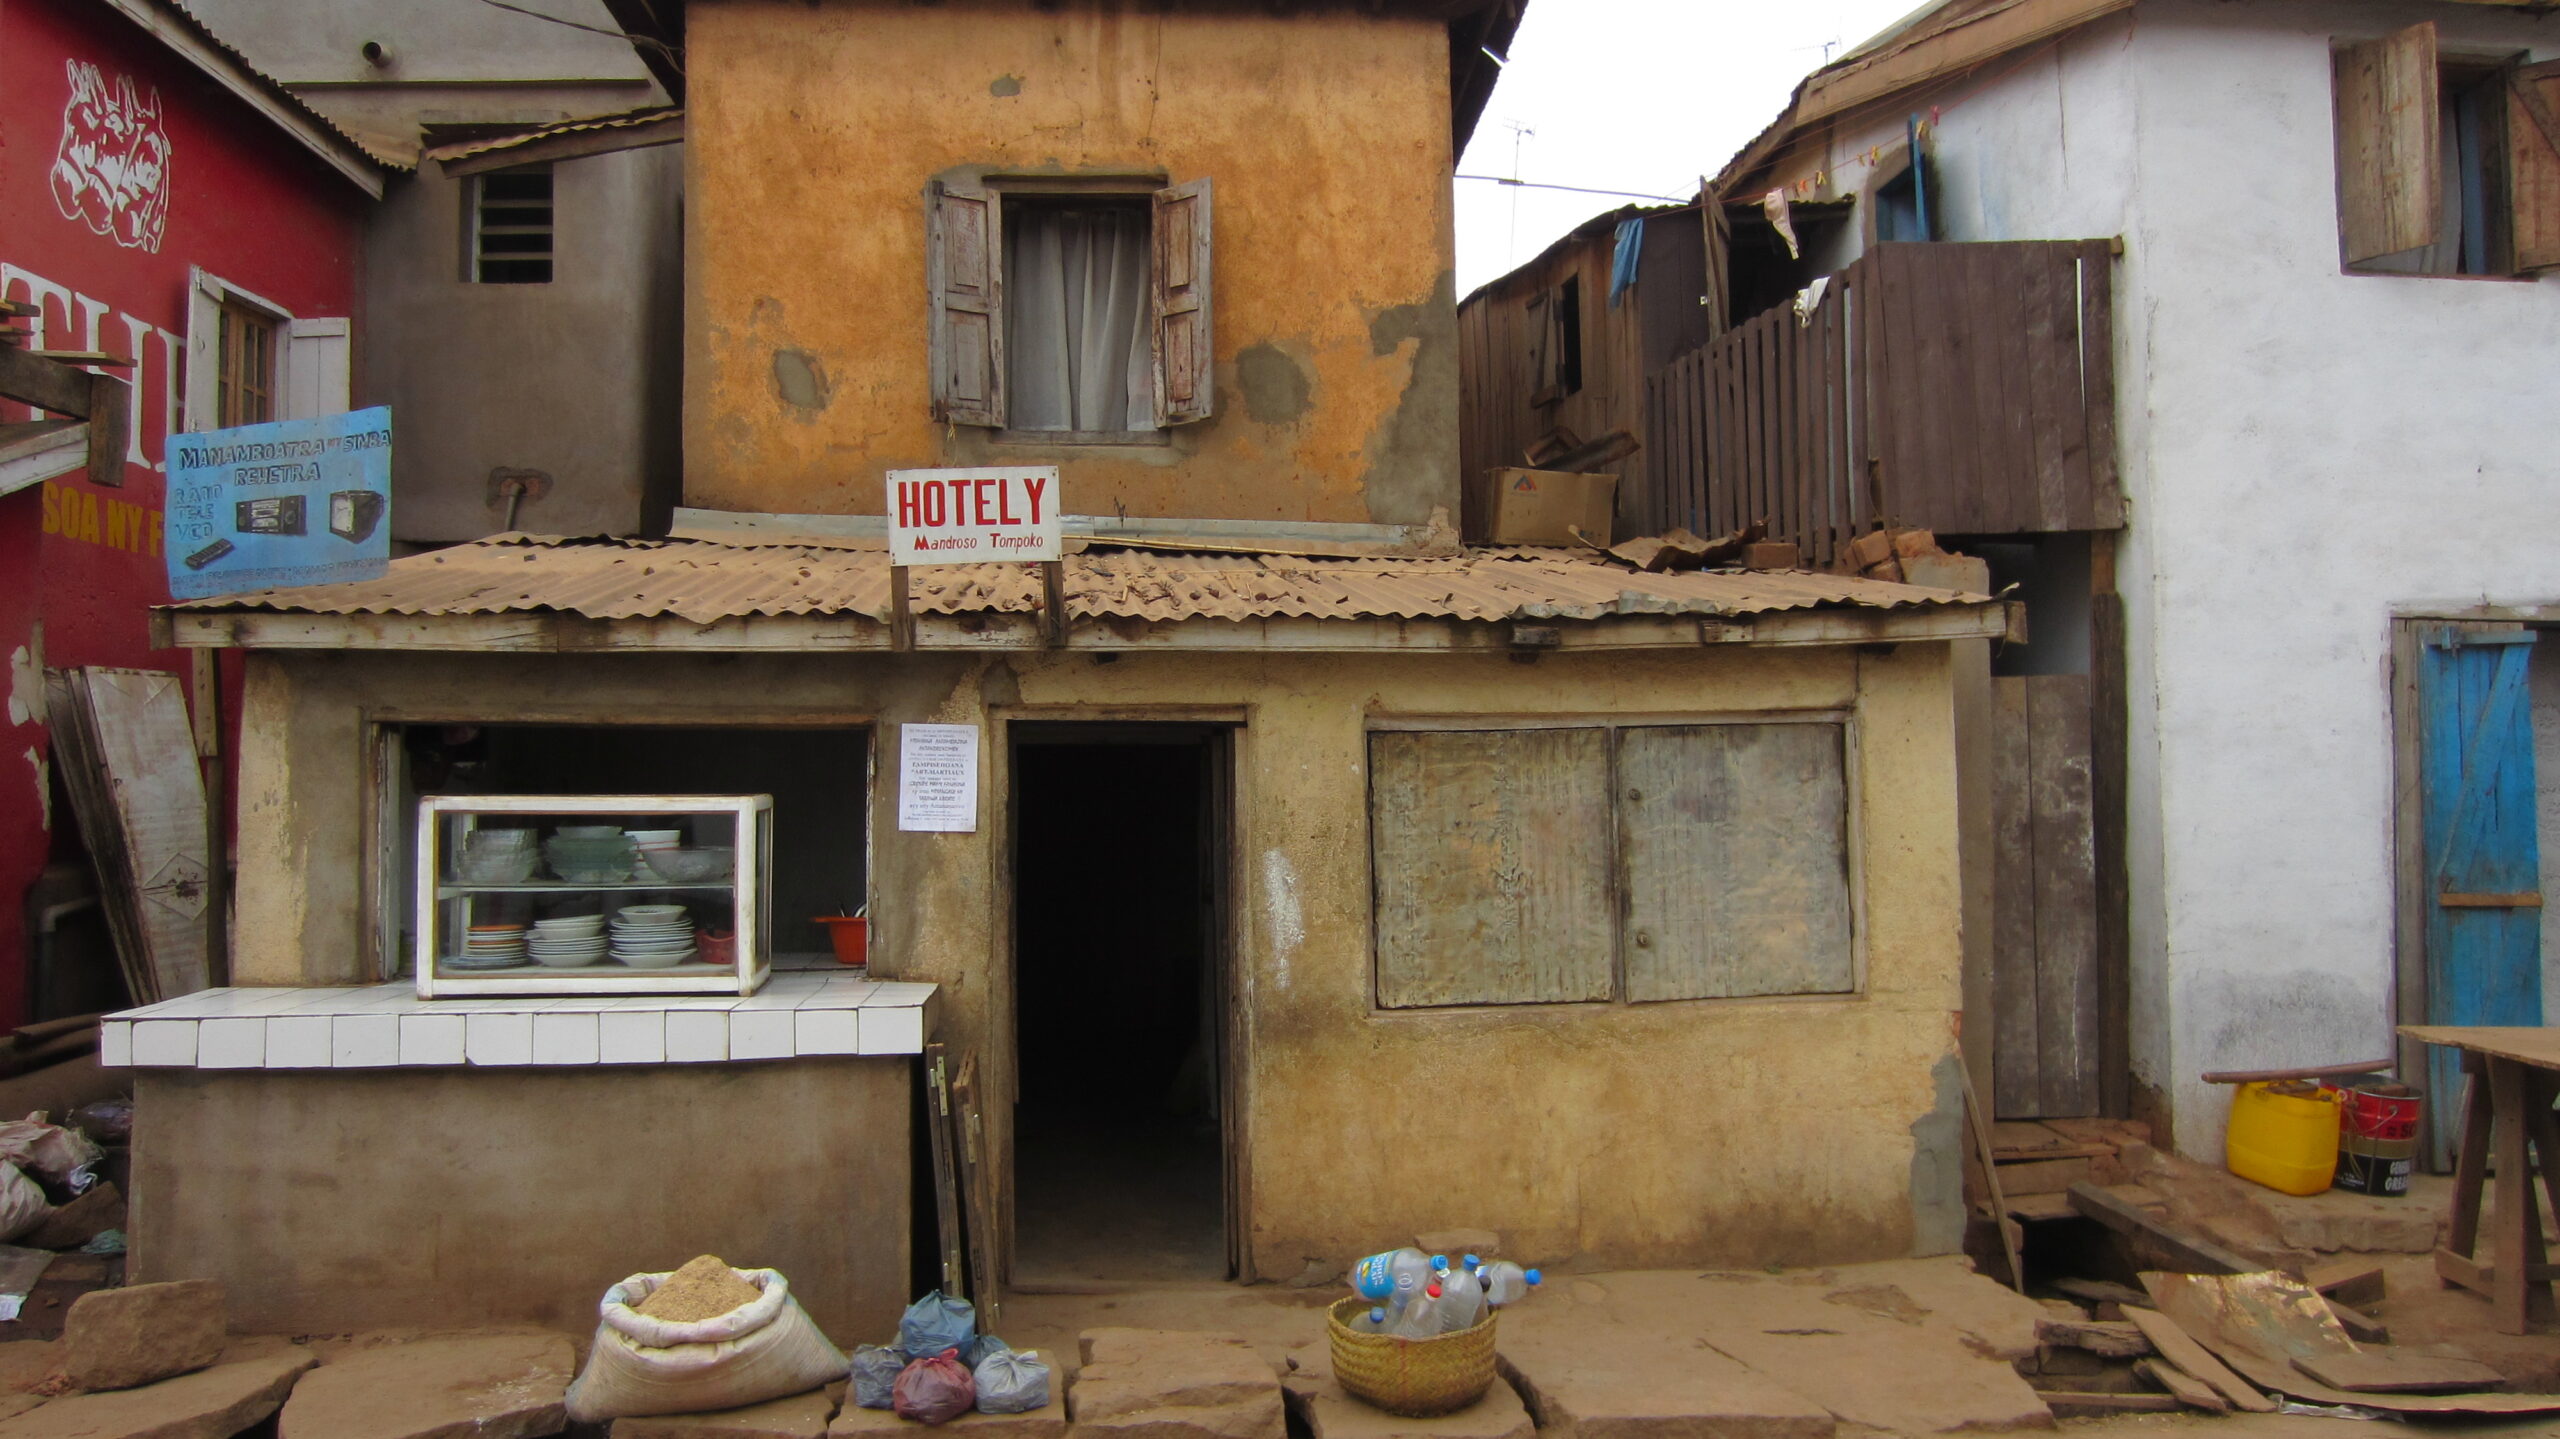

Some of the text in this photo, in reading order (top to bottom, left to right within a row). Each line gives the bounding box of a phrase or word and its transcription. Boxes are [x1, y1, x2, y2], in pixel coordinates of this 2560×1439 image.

[179, 440, 325, 470] MANAMBOATRA
[343, 429, 391, 452] SIMBA
[234, 462, 321, 487] REHETRA
[42, 480, 100, 546] SOA
[106, 498, 143, 554] NY
[898, 478, 1046, 528] HOTELY
[914, 532, 1044, 554] Mandroso Tompoko
